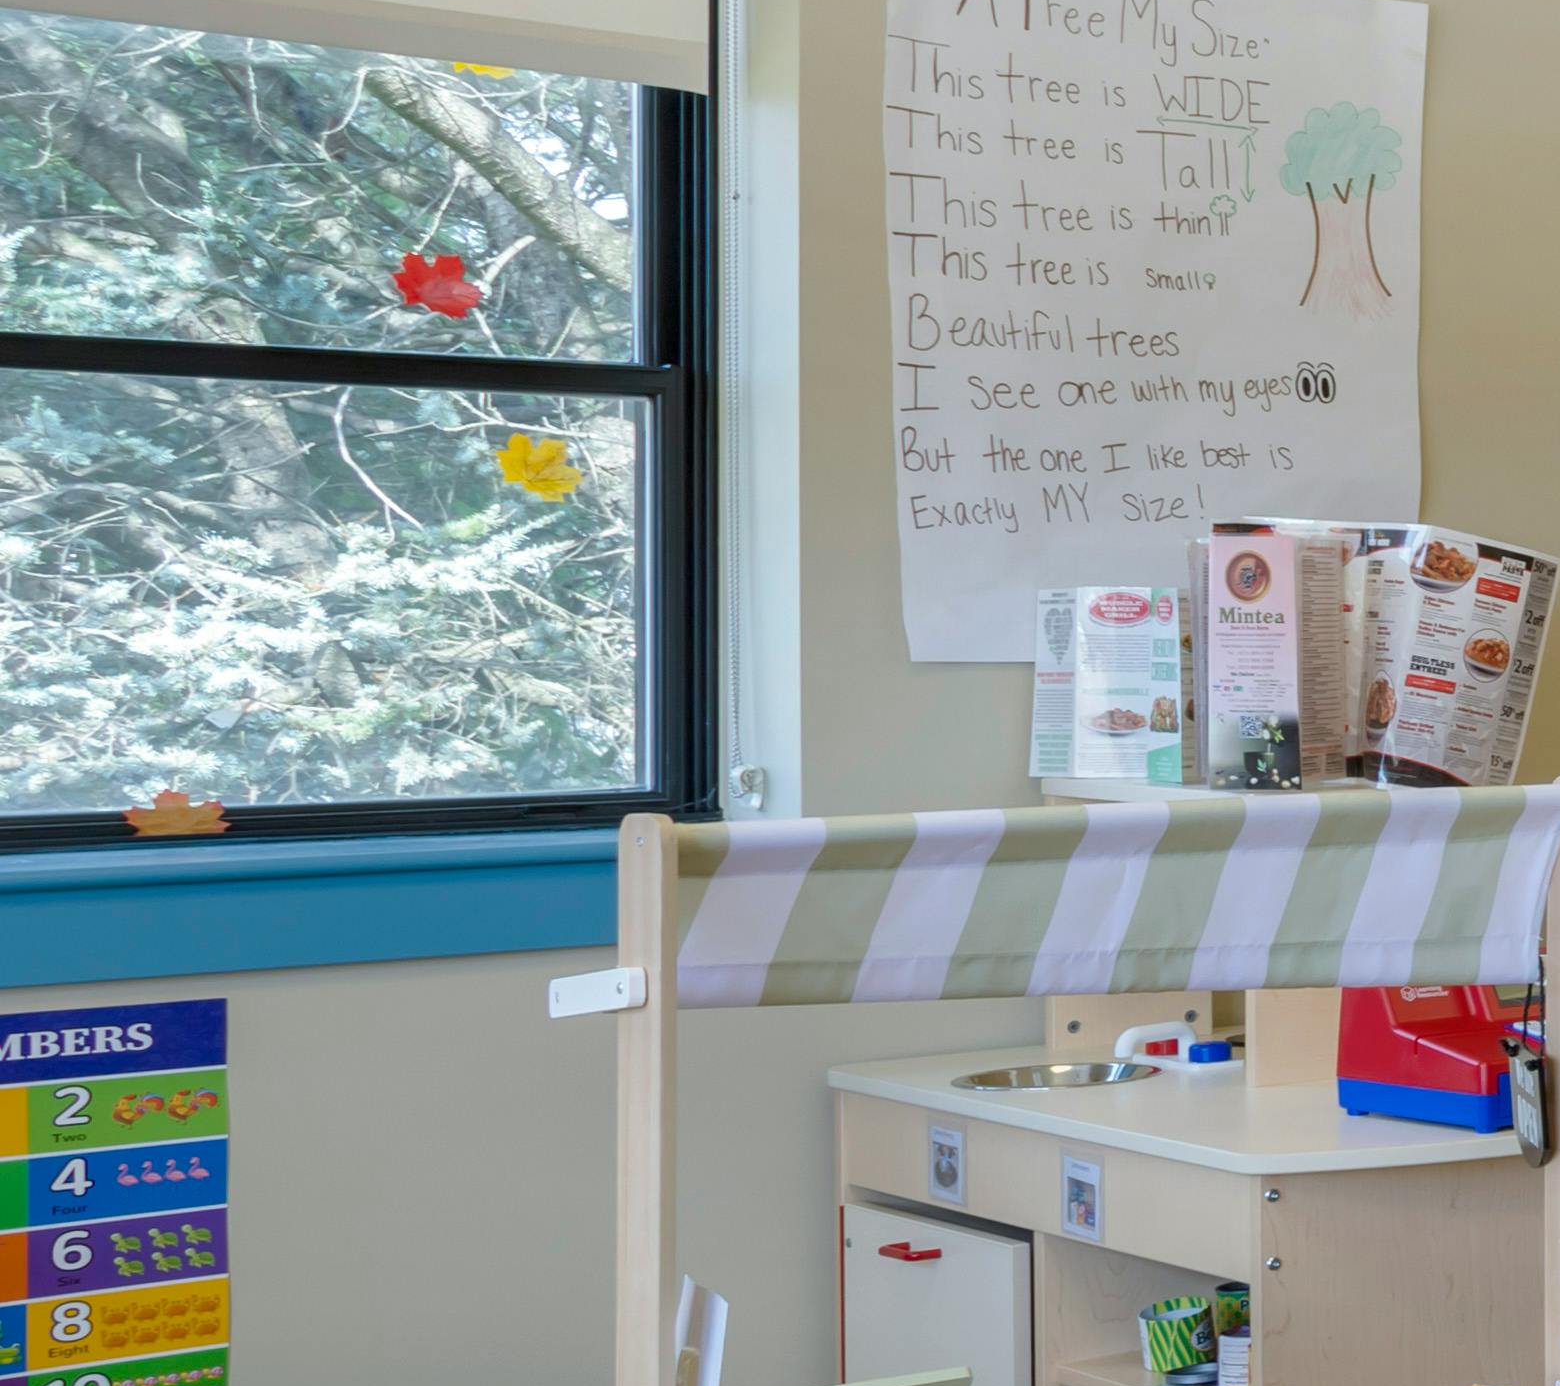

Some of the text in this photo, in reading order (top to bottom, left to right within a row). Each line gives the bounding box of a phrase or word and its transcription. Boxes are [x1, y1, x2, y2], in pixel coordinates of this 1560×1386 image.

[888, 34, 1271, 124] This tree is WIDE
[887, 105, 1230, 191] This tree is Tall
[889, 171, 1212, 237] This tree is thin
[892, 231, 988, 281] This
[1005, 242, 1077, 286] tree
[1088, 258, 1110, 286] is
[908, 292, 1180, 357] Beautiful trees
[898, 362, 940, 411] I
[1058, 379, 1118, 407] one
[1131, 376, 1189, 404] with
[1200, 379, 1237, 417] my
[1243, 376, 1292, 413] eyes
[901, 425, 1295, 474] But the one I like best is
[911, 494, 1020, 533] Exactly
[1042, 482, 1090, 524] MY
[1218, 607, 1285, 624] Mintea
[54, 1085, 92, 1128] 2
[52, 1131, 88, 1144] Two
[50, 1156, 94, 1198] 4
[51, 1203, 88, 1216] Four
[51, 1228, 93, 1273] 6
[57, 1275, 82, 1289] Six
[50, 1300, 93, 1345] 8
[47, 1341, 91, 1360] Eight
